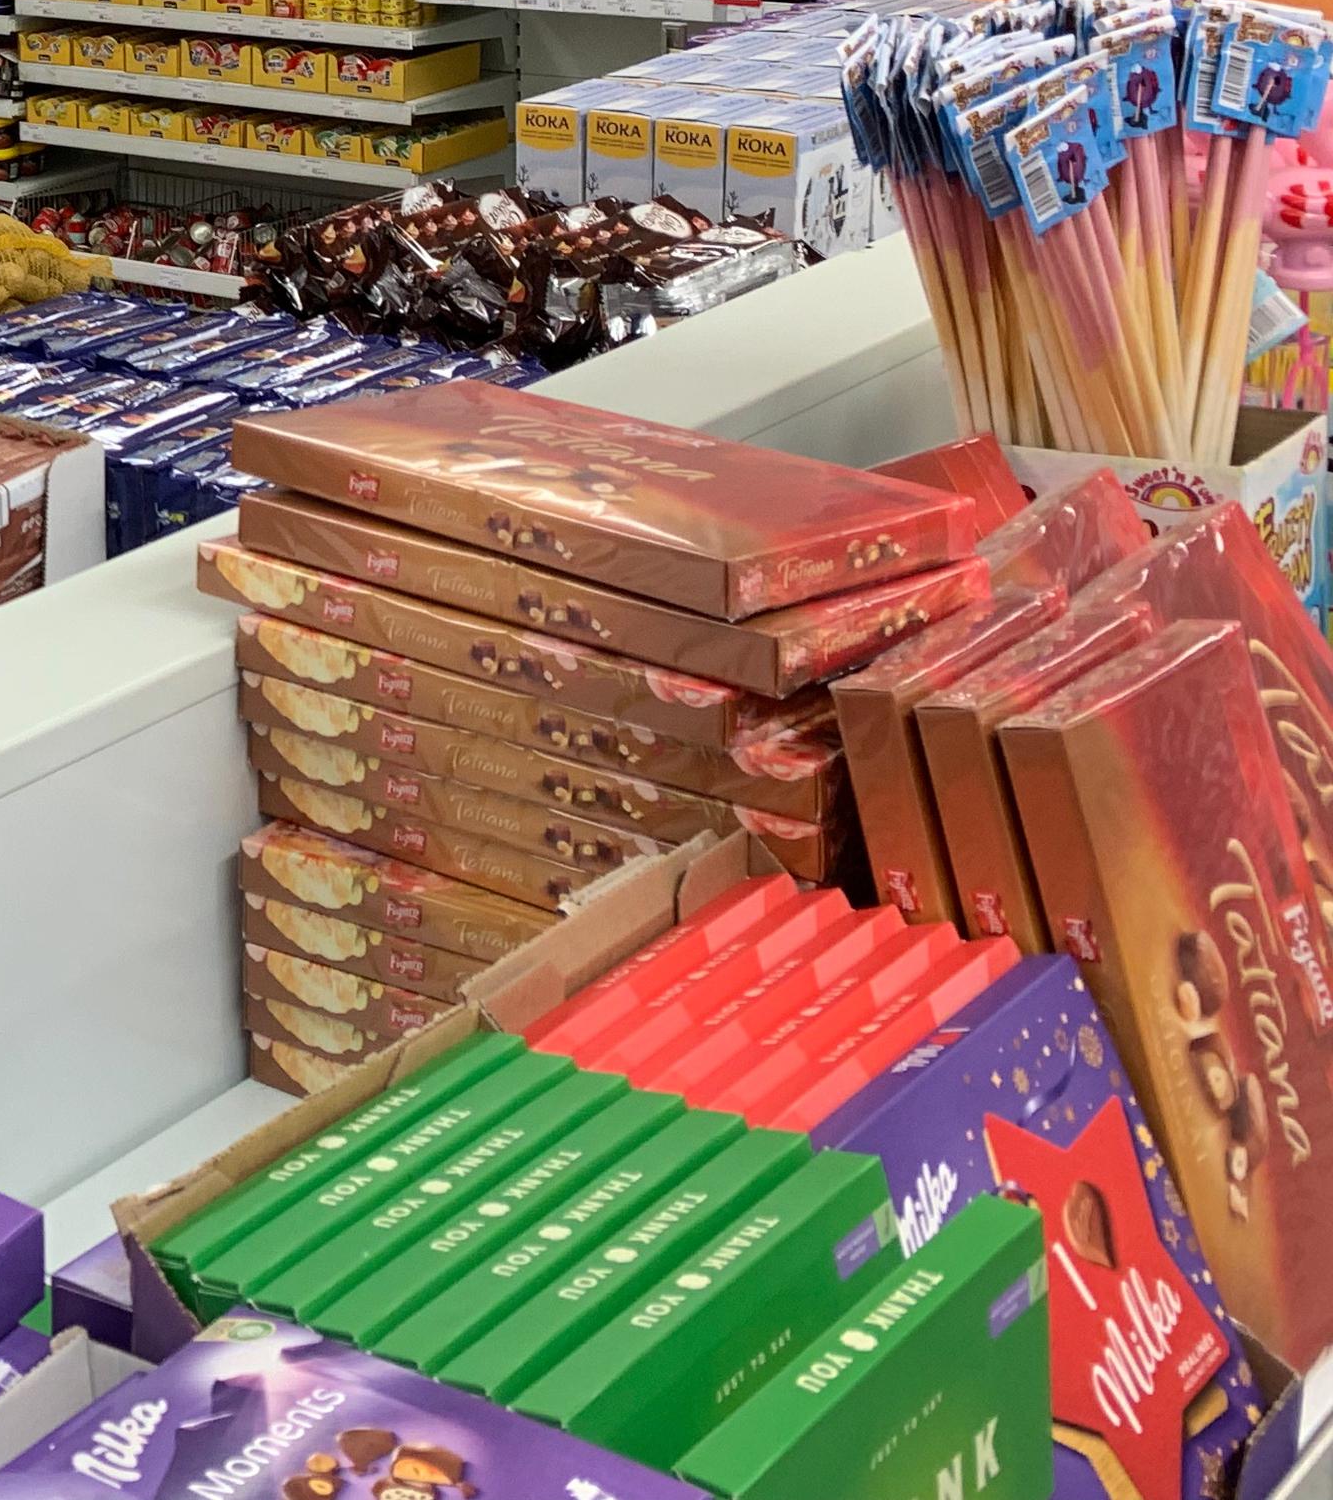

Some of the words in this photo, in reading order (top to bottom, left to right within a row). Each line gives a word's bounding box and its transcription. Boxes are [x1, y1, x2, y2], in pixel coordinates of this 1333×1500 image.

[481, 414, 716, 484] Tatiana
[405, 487, 468, 524] Tatiana
[428, 565, 496, 601] Tatiana
[384, 615, 450, 651] Tatiana
[443, 688, 516, 725] Tatiana
[447, 745, 519, 780] Tatiana
[451, 794, 521, 832] Tatiana
[455, 846, 524, 885] Tatiana
[1282, 902, 1332, 1026] Figaro
[1210, 838, 1311, 1168] Tatiana
[392, 1108, 471, 1156] THANK
[268, 1152, 320, 1182] YOU
[445, 1128, 524, 1178] THANK
[319, 1176, 371, 1206] YOU
[900, 1161, 957, 1259] Milka
[373, 1197, 426, 1229] YOU
[702, 1216, 780, 1270] THANK
[631, 1294, 685, 1329] YOU
[864, 1270, 943, 1330] THANK
[1092, 1267, 1182, 1434] Milka
[796, 1353, 853, 1393] YOU
[72, 1399, 170, 1489] Milka
[188, 1385, 347, 1500] Moments
